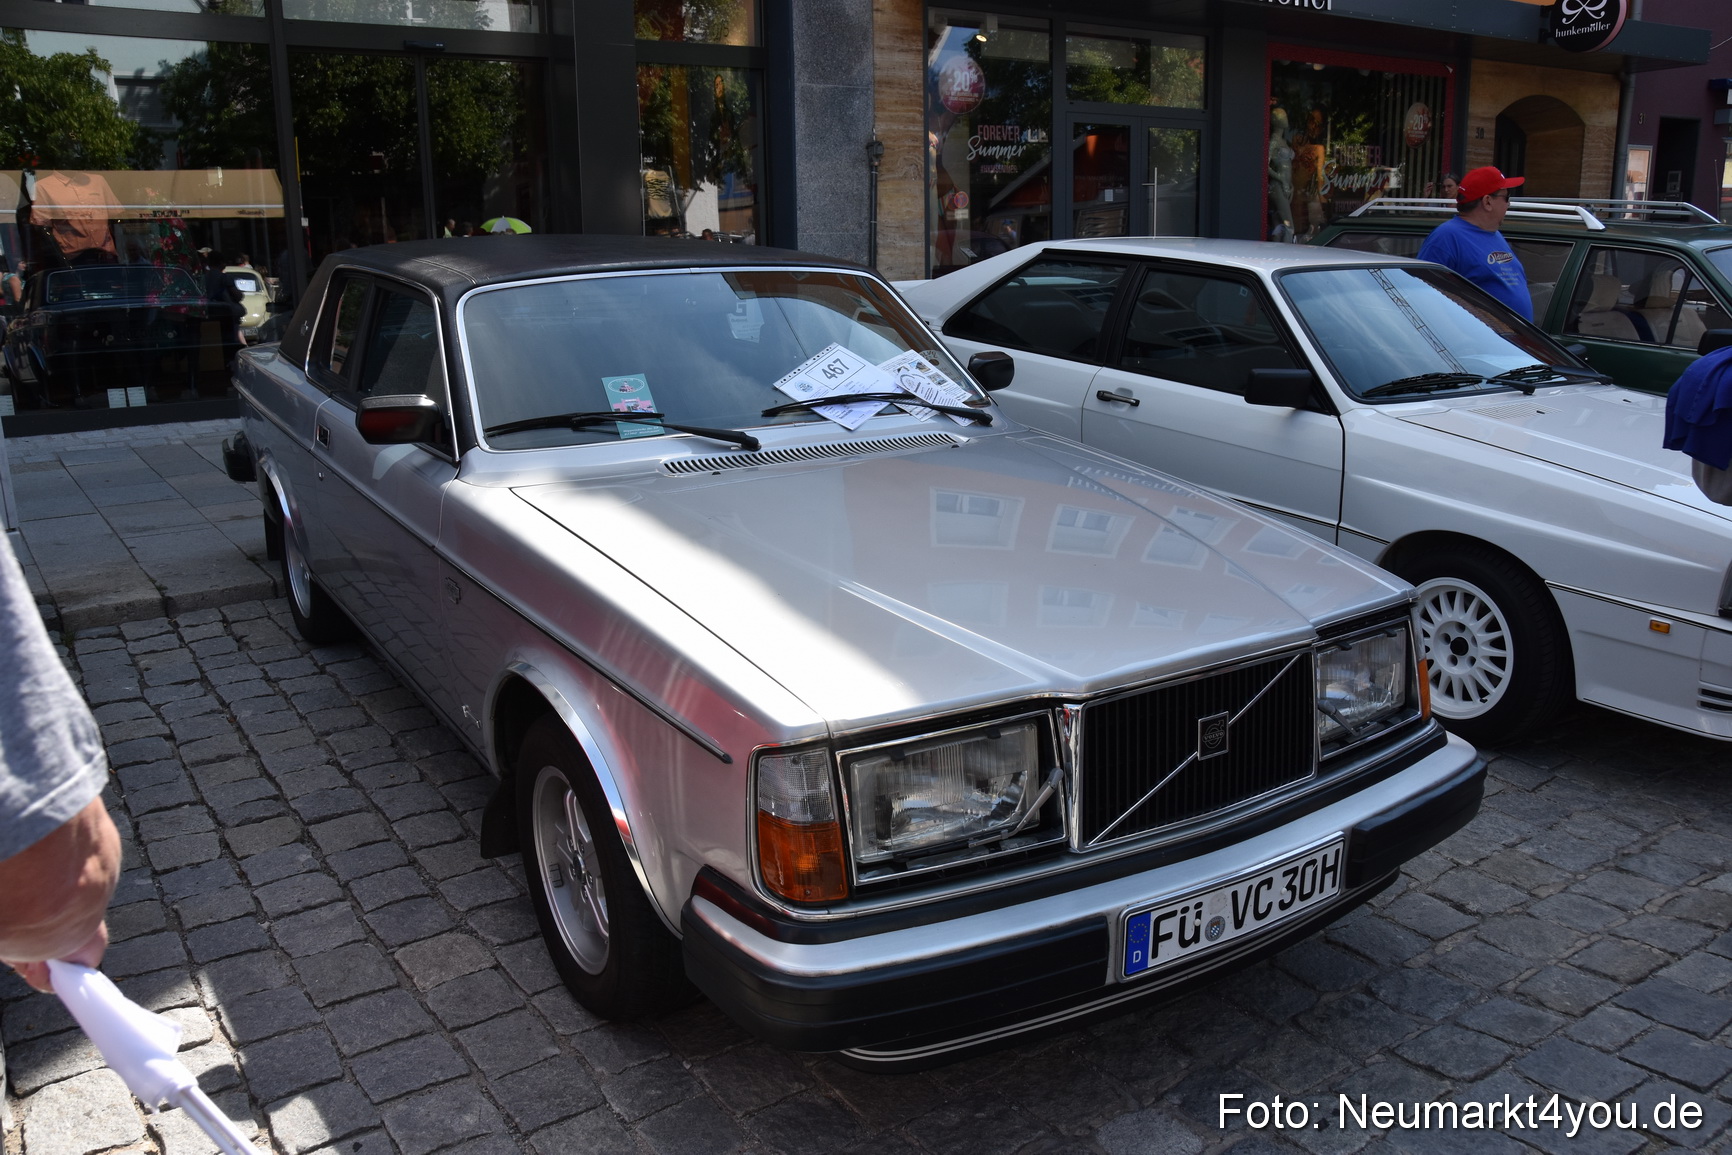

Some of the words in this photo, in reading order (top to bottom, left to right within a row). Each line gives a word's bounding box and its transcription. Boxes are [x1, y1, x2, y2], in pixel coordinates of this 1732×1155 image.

[1555, 21, 1611, 38] hunkemöller
[1638, 113, 1646, 125] 31
[977, 125, 1020, 142] FOREVER
[1475, 127, 1484, 139] 30
[966, 135, 1027, 161] Summer
[1319, 160, 1389, 196] Summer
[821, 358, 850, 379] 467
[1203, 731, 1224, 740] VOLVO
[1133, 950, 1142, 963] D
